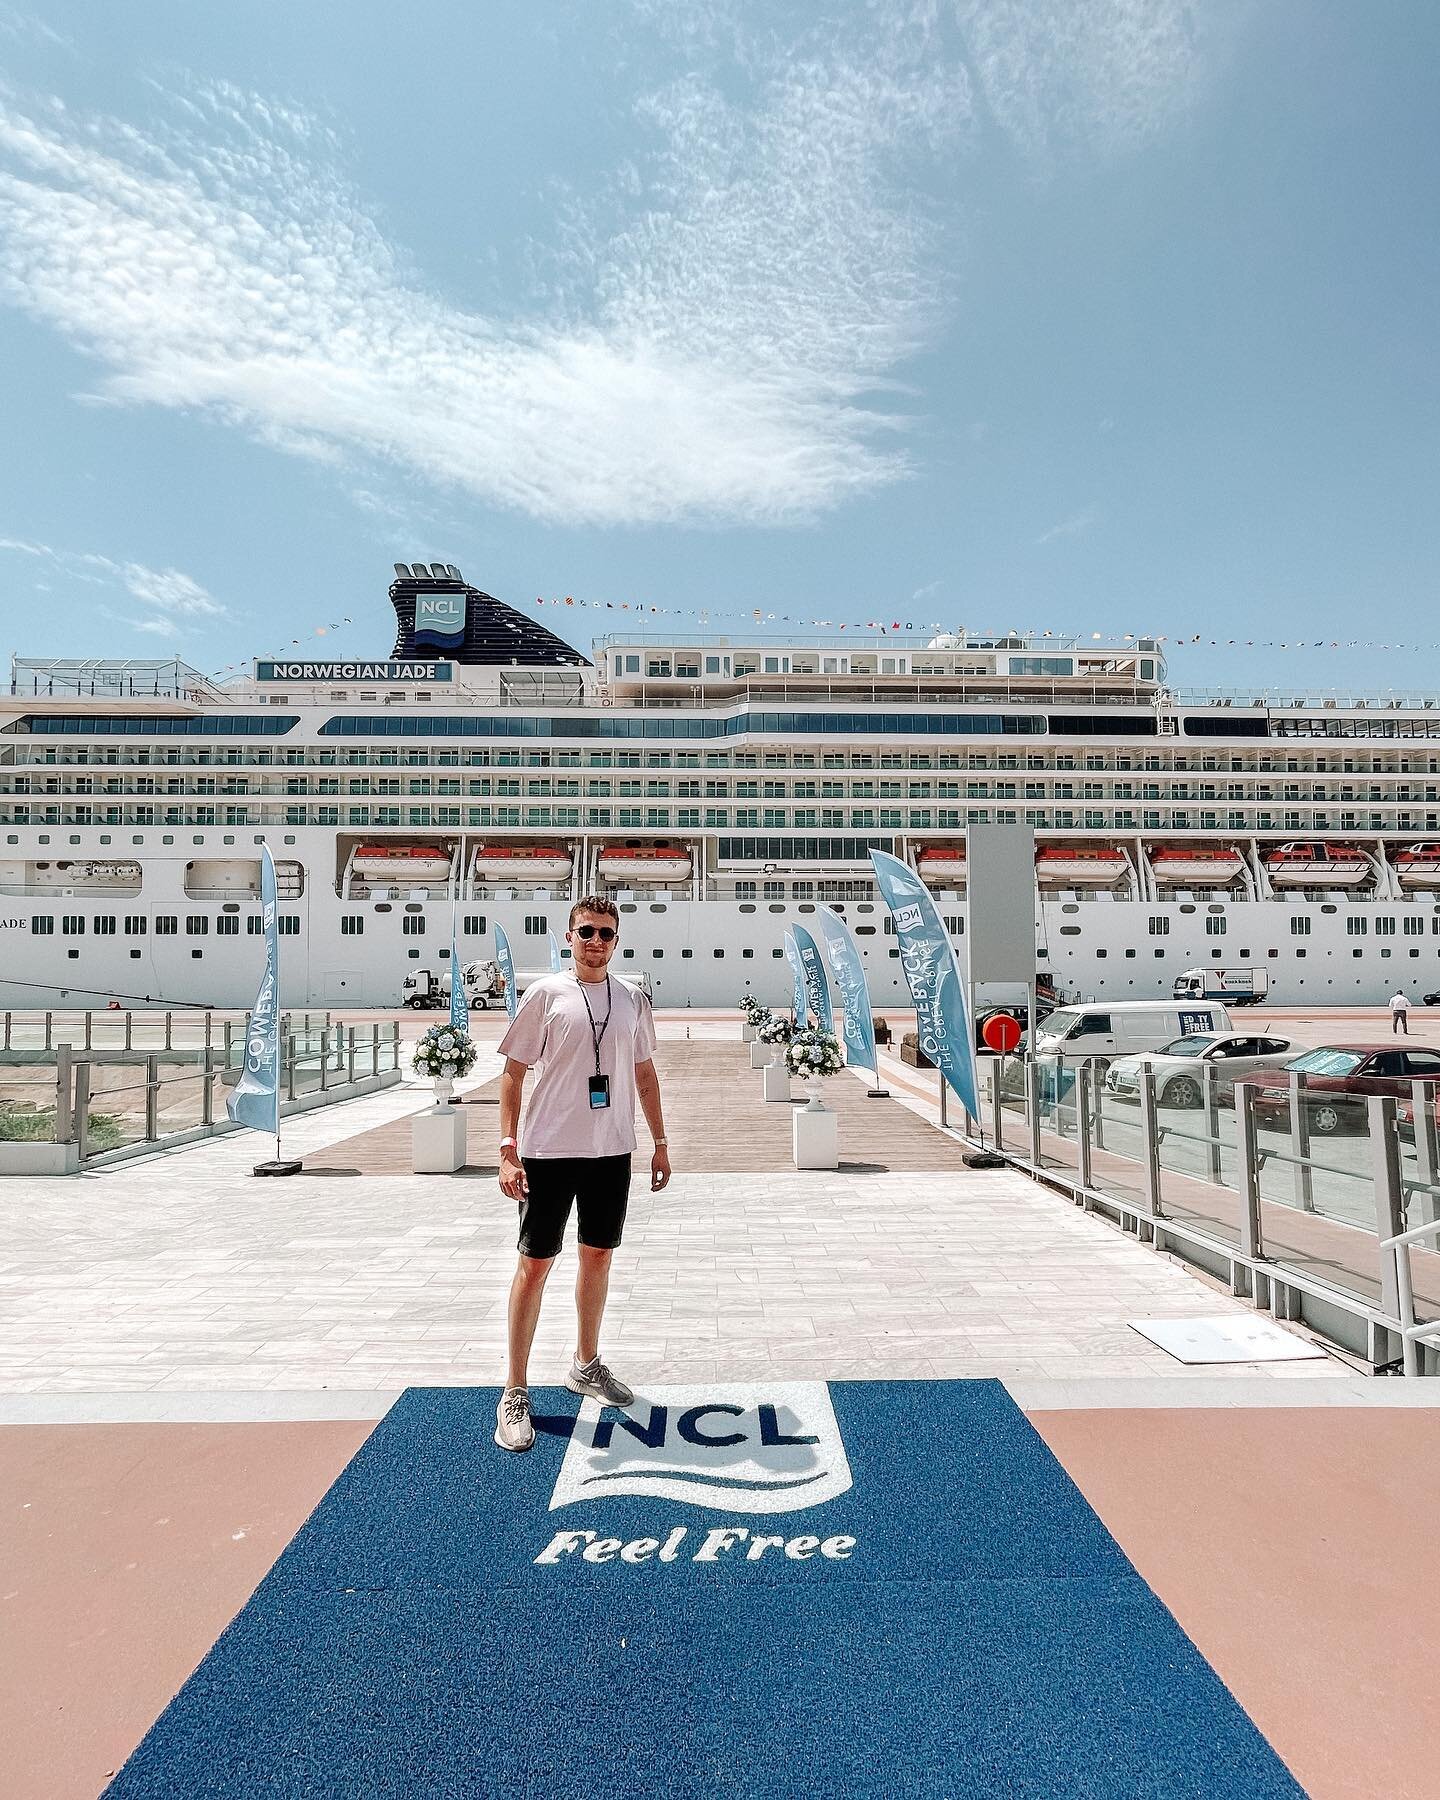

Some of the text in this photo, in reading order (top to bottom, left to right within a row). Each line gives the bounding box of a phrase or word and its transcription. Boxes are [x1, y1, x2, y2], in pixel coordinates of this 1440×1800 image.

[421, 600, 460, 615] NCL
[273, 664, 435, 680] NORWEGIAN JADE
[1190, 1022, 1210, 1032] FREE
[591, 1403, 820, 1448] NCL
[533, 1527, 857, 1564] Feel Free
